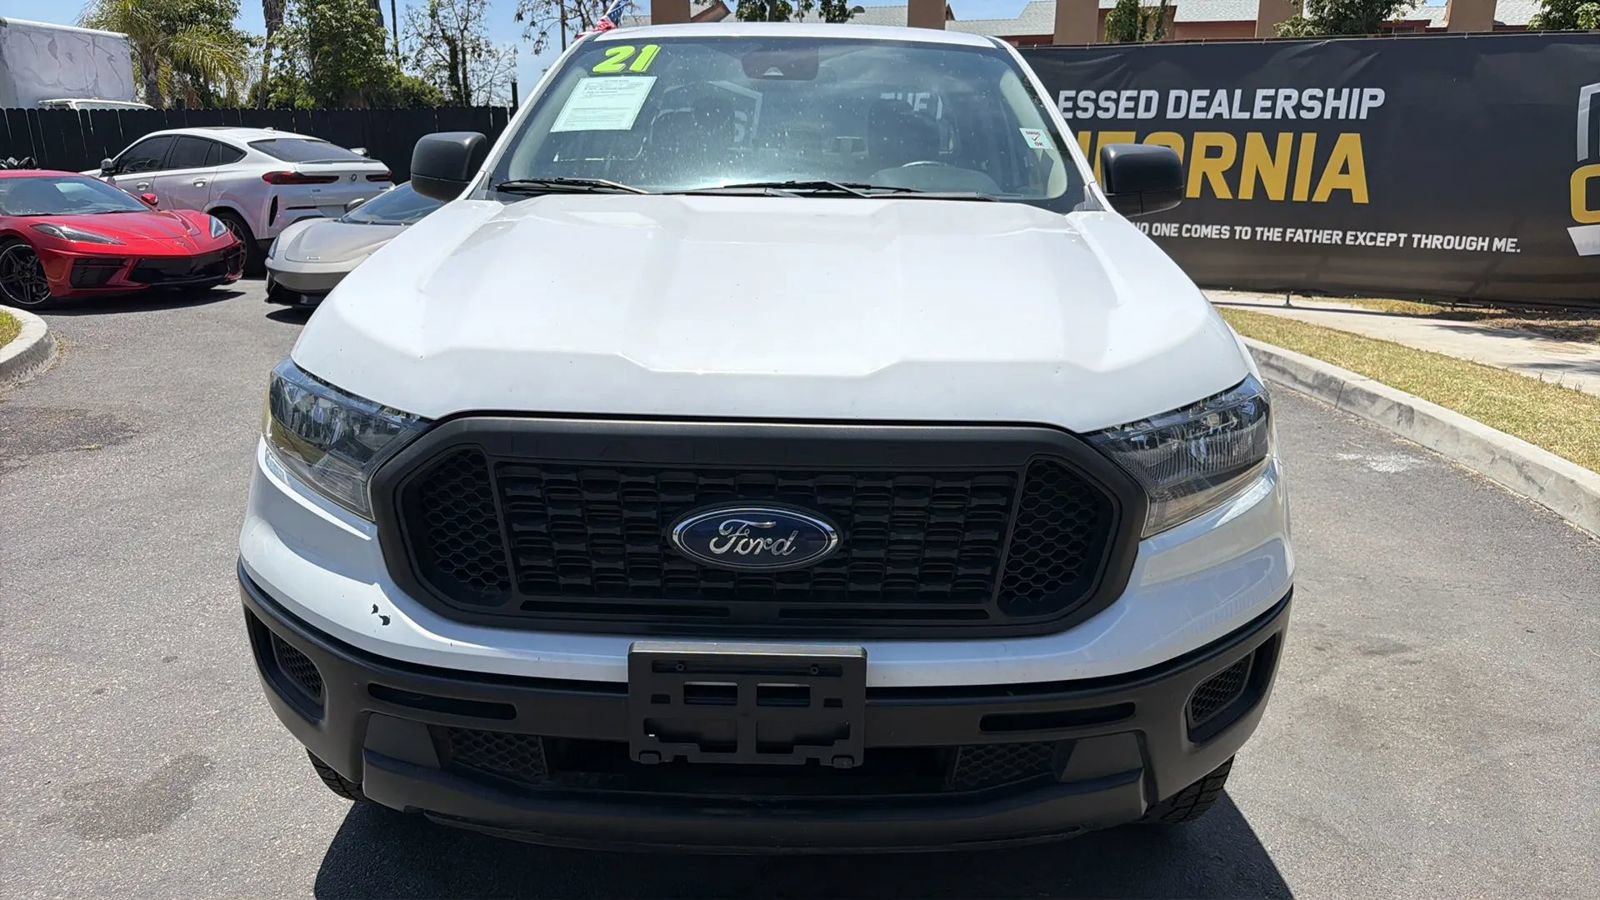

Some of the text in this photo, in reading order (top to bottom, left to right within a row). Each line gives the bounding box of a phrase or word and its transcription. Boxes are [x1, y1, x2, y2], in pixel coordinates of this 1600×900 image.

[592, 44, 662, 73] 21
[1058, 87, 1386, 120] ESSED DEALERSHIP
[1151, 222, 1180, 237] ONE
[1181, 224, 1231, 239] COMES
[1234, 226, 1251, 240] TO
[1255, 227, 1284, 242] THE
[1285, 228, 1343, 244] FATHER
[1345, 231, 1408, 248] EXCEPT
[1411, 234, 1489, 252] THROUGH
[1492, 237, 1521, 253] ME.
[709, 519, 799, 556] Ford
